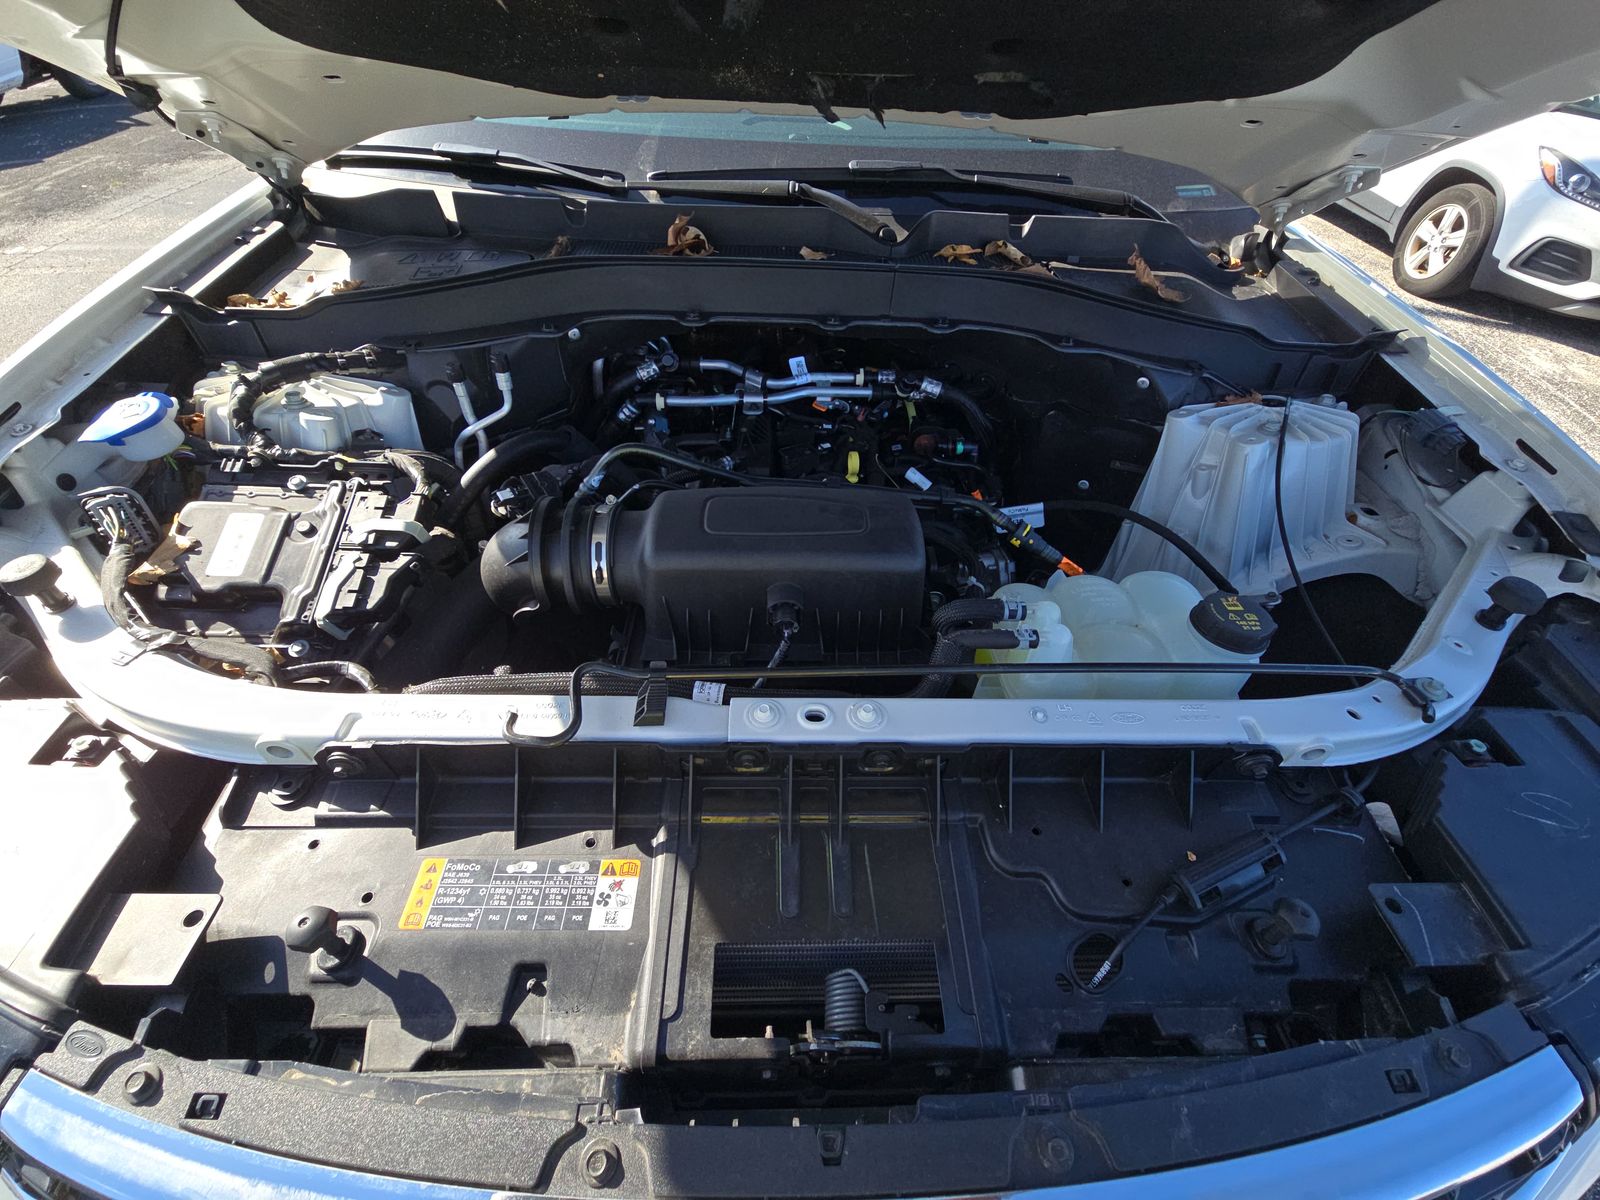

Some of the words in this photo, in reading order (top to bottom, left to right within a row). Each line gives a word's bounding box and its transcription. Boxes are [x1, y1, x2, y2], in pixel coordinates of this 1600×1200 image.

[445, 863, 481, 872] FoMoCo
[437, 888, 471, 896] R-1234yf
[505, 887, 514, 896] kg
[532, 887, 540, 896] kg
[560, 887, 569, 896] kg
[587, 887, 595, 896] kg
[434, 897, 456, 905] (GWP
[456, 897, 465, 905] 4)
